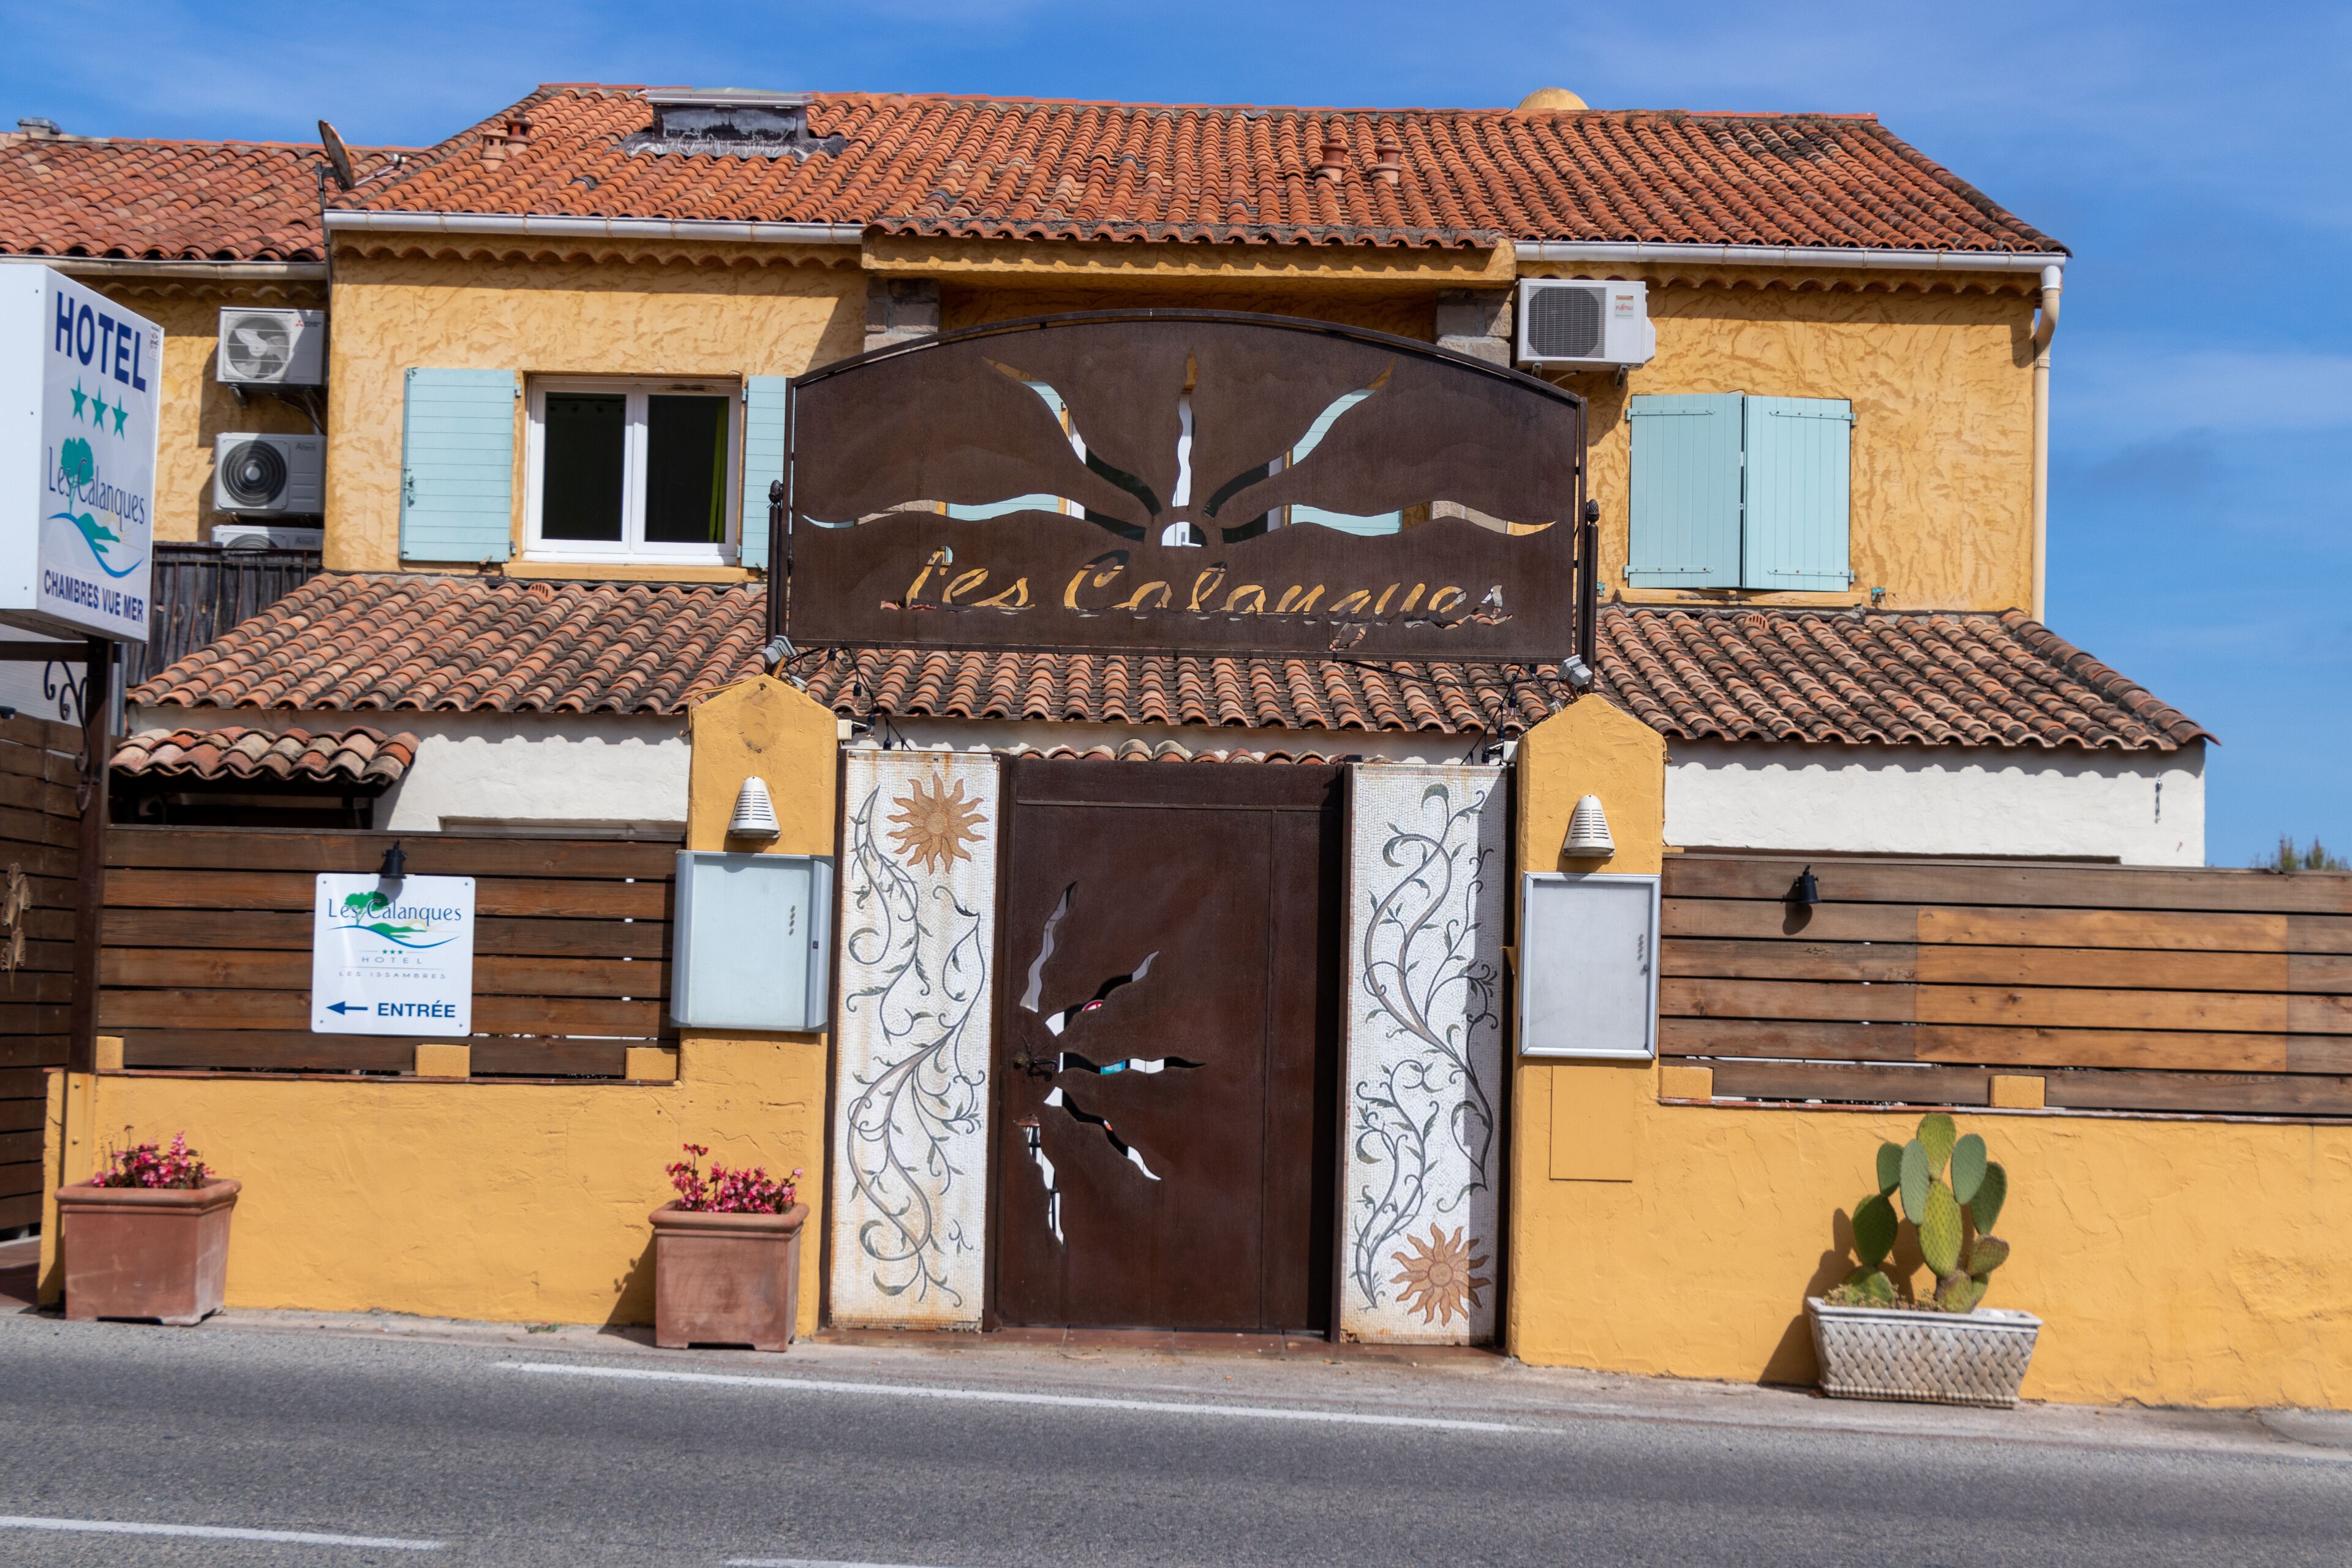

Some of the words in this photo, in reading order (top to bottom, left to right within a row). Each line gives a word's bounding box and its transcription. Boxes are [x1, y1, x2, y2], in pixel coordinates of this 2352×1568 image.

[56, 290, 146, 393] HOTEL
[49, 446, 71, 497] Les
[77, 458, 145, 532] Calanques
[44, 569, 99, 609] CHAMBRES
[102, 587, 121, 616] VUE
[124, 594, 144, 624] MER
[1064, 549, 1513, 652] Calanques
[328, 898, 358, 918] Les
[367, 898, 462, 927] Calanques
[377, 1000, 456, 1018] ENTRÉE
